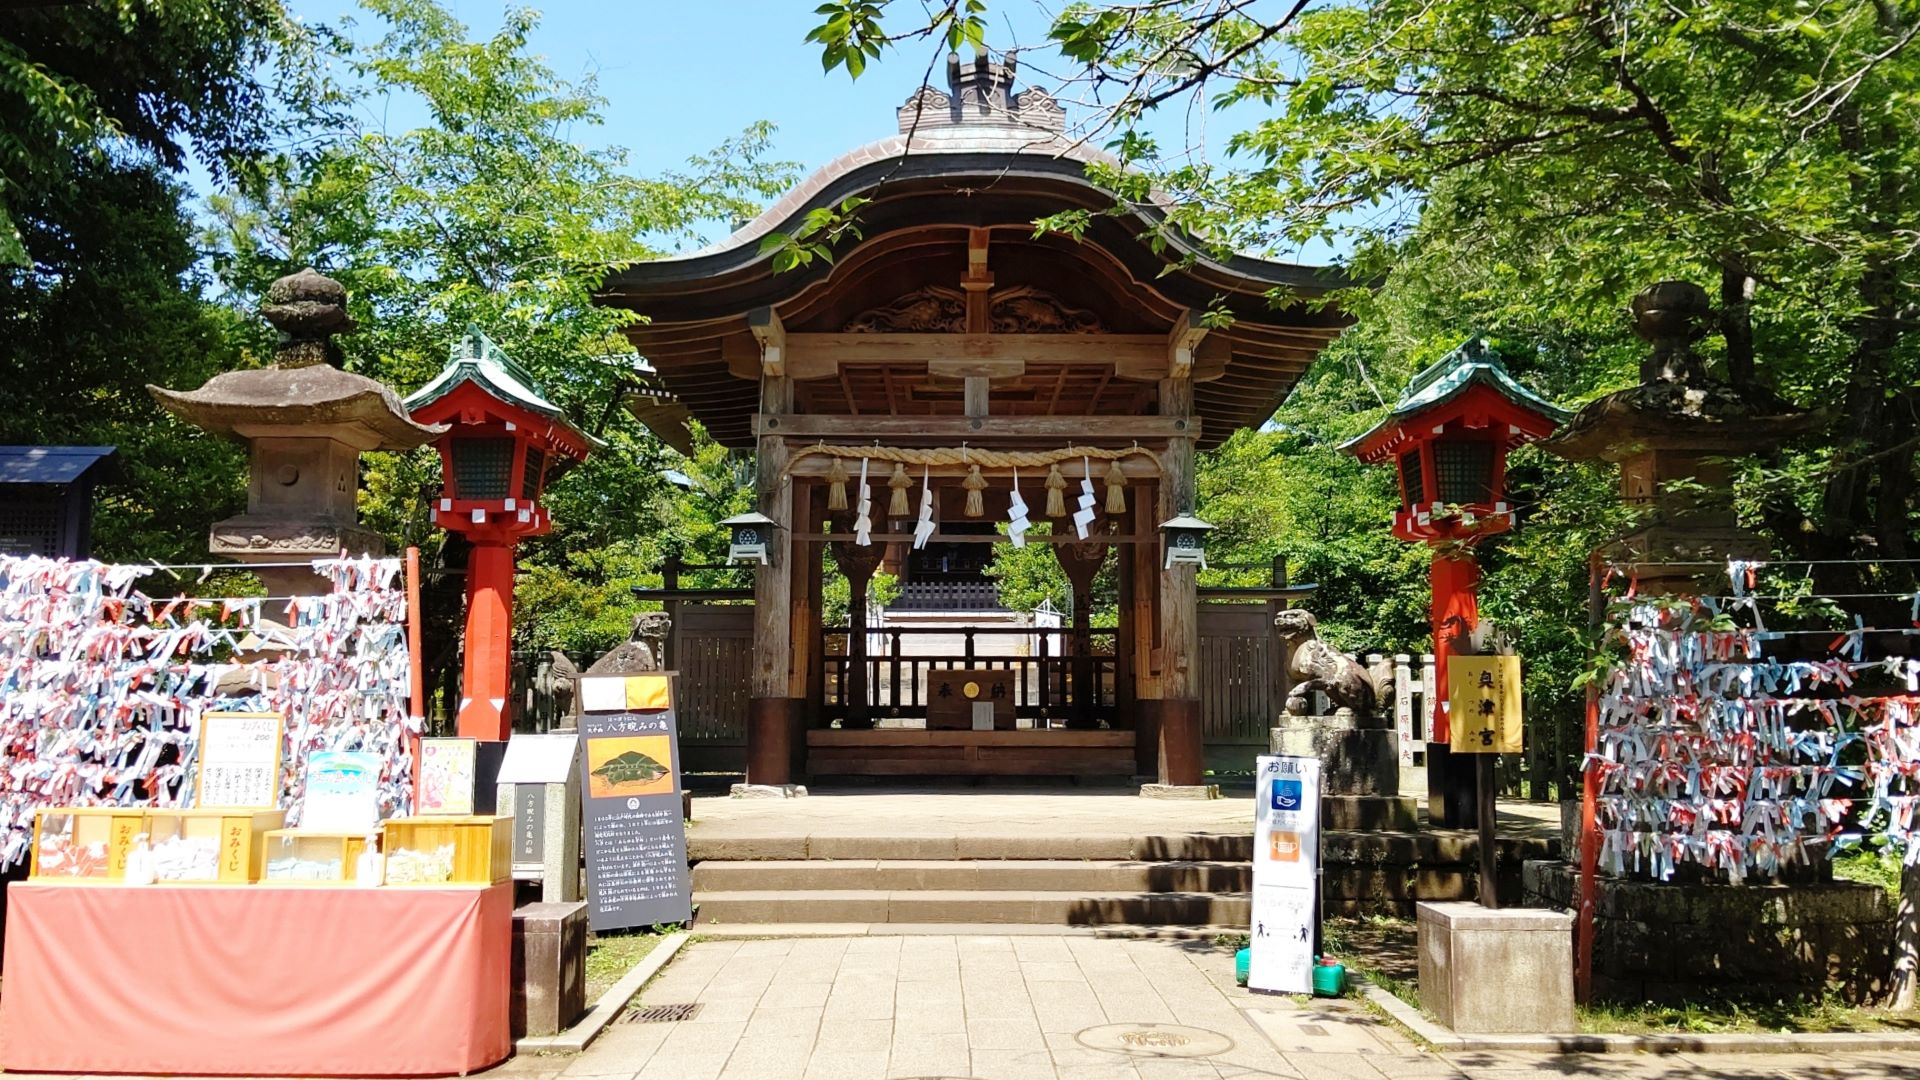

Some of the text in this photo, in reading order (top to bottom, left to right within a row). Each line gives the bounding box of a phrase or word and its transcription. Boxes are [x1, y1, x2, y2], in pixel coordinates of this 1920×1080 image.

[1478, 670, 1496, 746] 奥津宮
[1267, 761, 1308, 774] お願い
[229, 826, 242, 872] おみくじ
